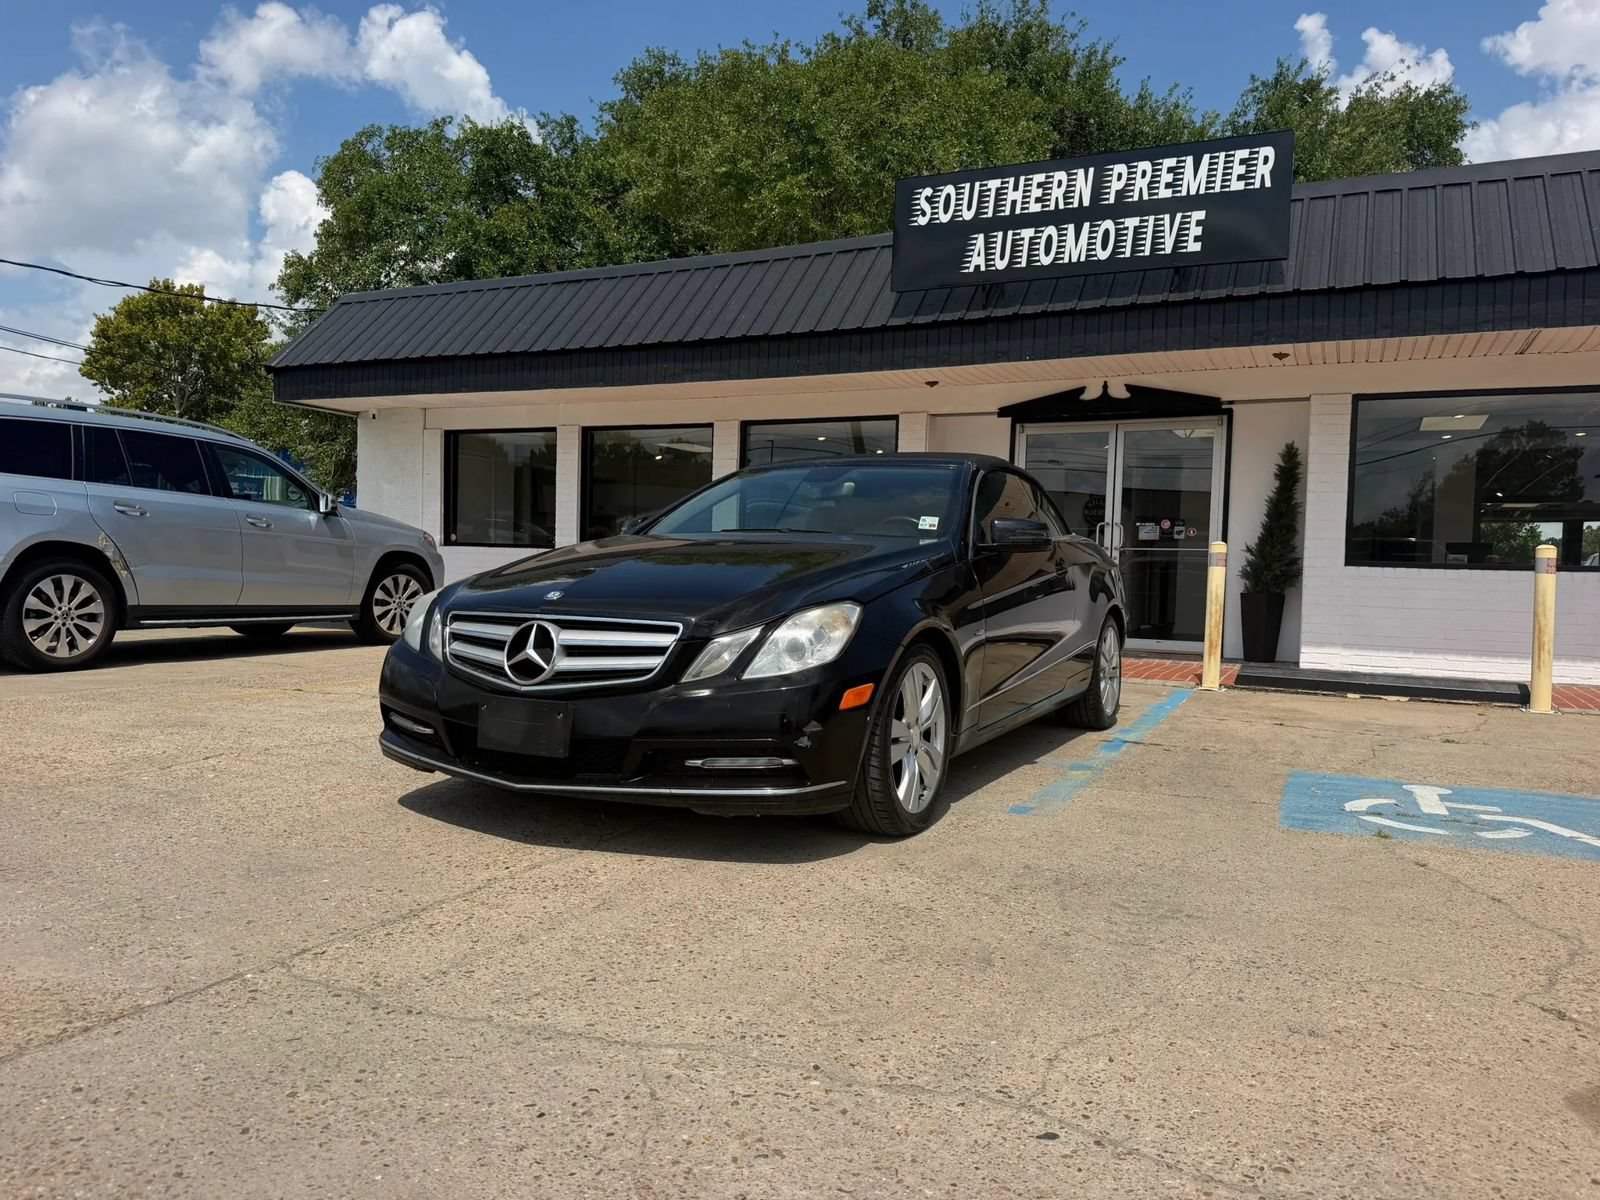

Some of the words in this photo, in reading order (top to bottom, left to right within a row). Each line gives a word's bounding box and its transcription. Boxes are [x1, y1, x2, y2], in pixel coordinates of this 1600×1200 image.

[908, 167, 1095, 226] SOUTHERN
[1098, 146, 1276, 205] PREMIER
[959, 210, 1206, 273] AUTOMOTIVE
